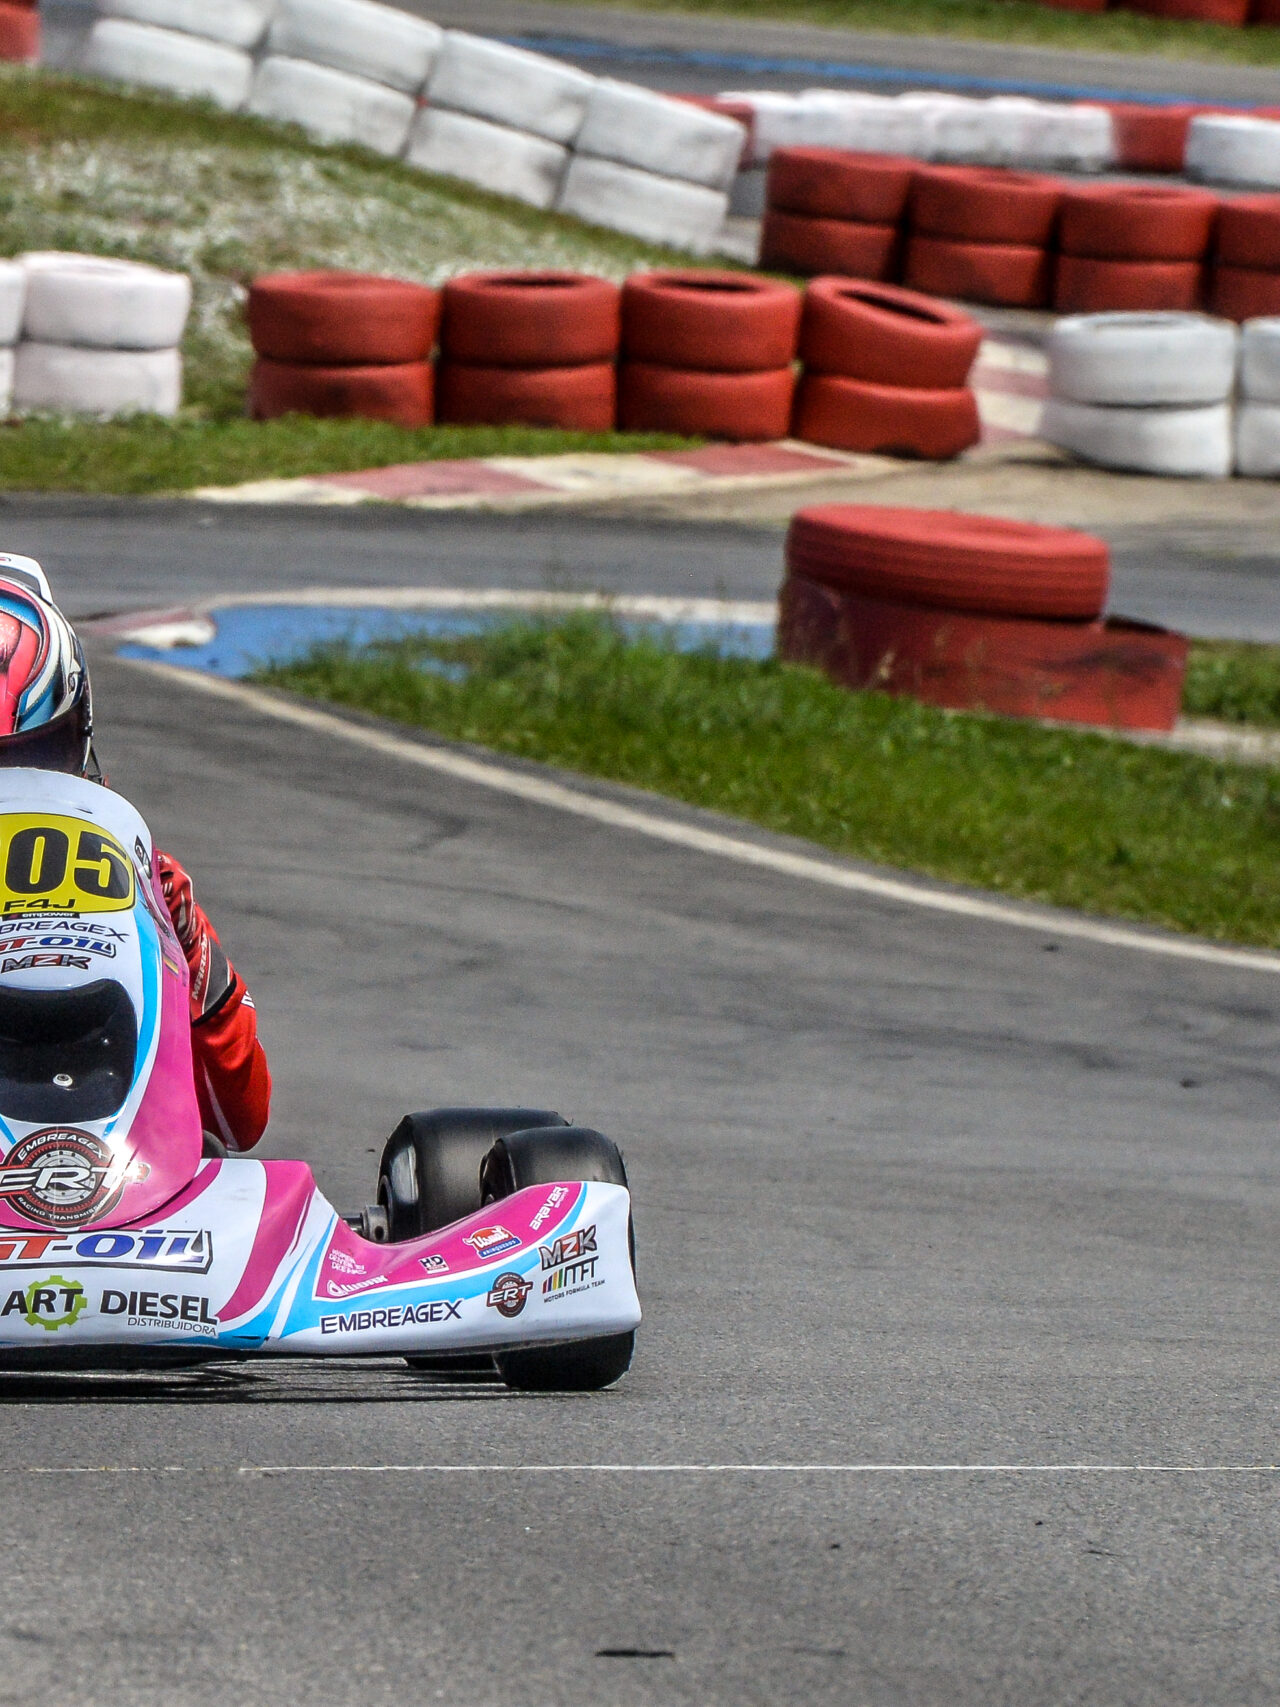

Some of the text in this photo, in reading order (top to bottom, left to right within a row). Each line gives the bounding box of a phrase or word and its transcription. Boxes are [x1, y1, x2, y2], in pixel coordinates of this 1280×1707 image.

[3, 898, 76, 912] F4J
[22, 912, 74, 920] empower
[0, 953, 92, 974] MZK
[18, 1132, 106, 1162] EMBREAGEX
[17, 1197, 46, 1216] RACING
[539, 1224, 598, 1271] MZK
[489, 1284, 532, 1304] ERT
[544, 1279, 606, 1303] MOTORS FORMULA TEAM
[100, 1289, 218, 1325] DIESEL
[321, 1300, 462, 1334] EMBREAGEX
[128, 1317, 217, 1336] DISTRIBUIDORA
